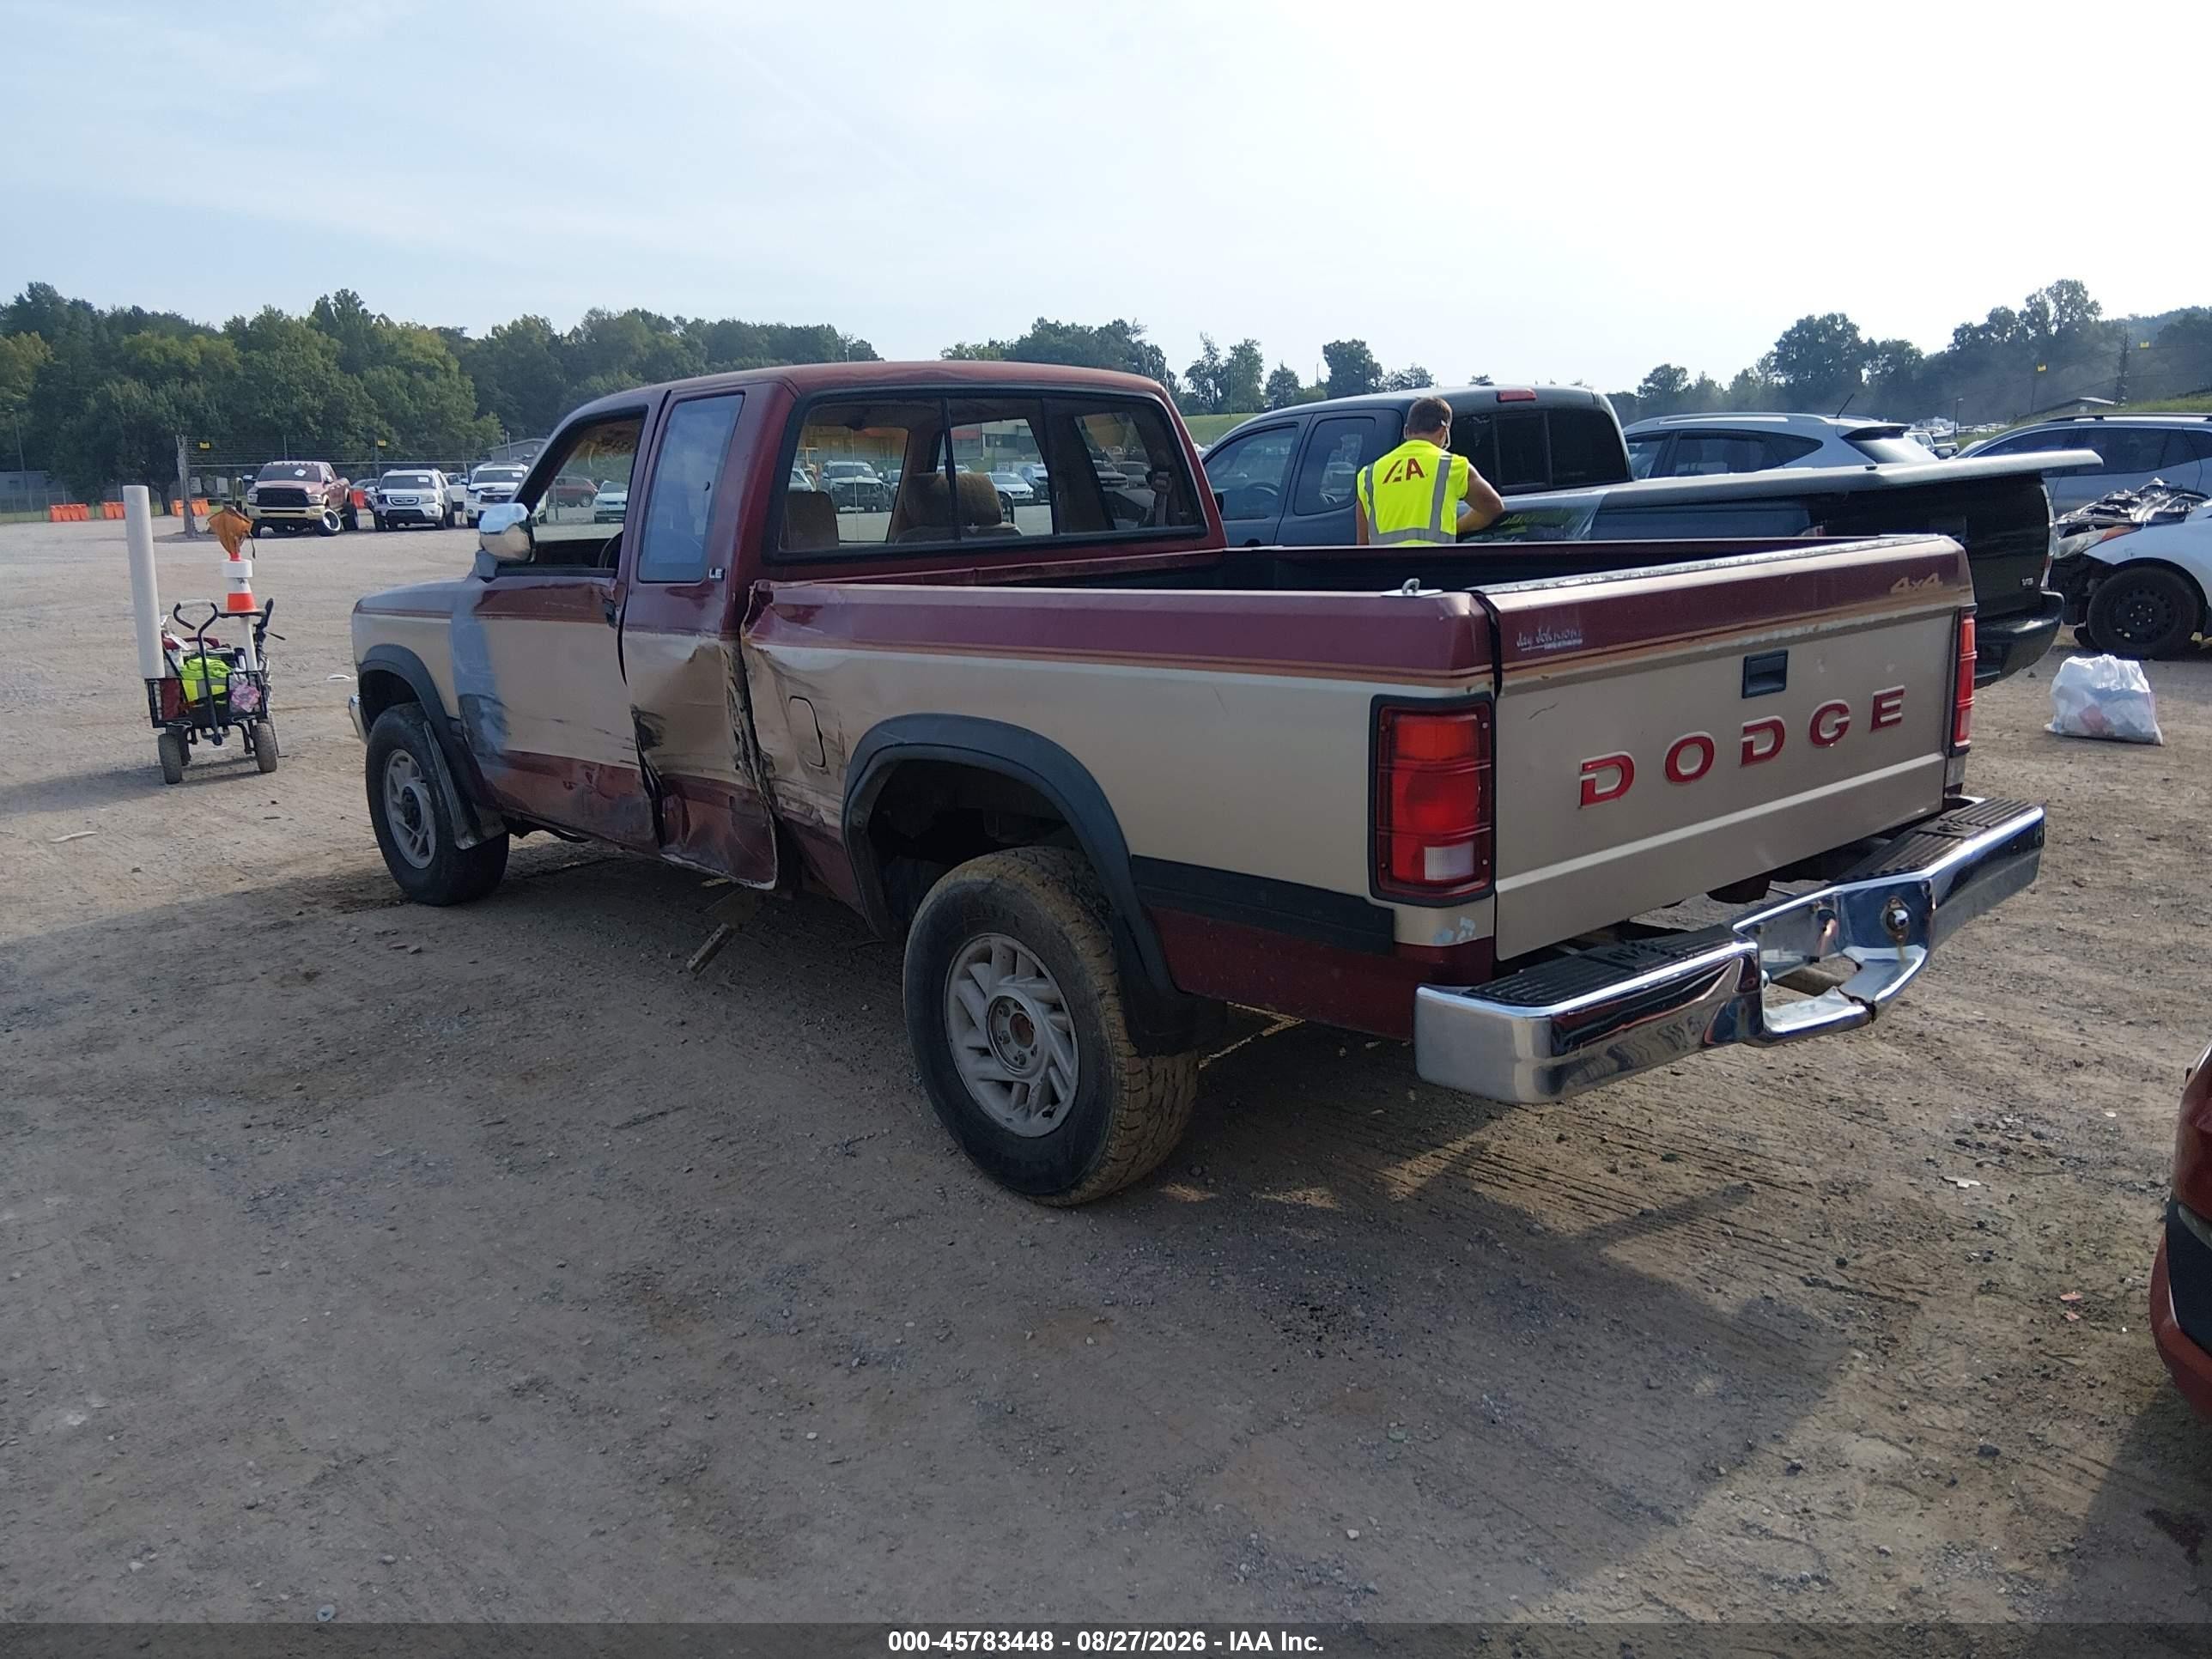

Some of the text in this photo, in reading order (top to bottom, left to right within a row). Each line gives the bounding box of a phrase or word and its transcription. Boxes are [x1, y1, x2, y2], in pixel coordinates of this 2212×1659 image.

[708, 568, 722, 579] LE
[1890, 572, 1943, 594] 4x4
[1579, 684, 1905, 809] DODGE
